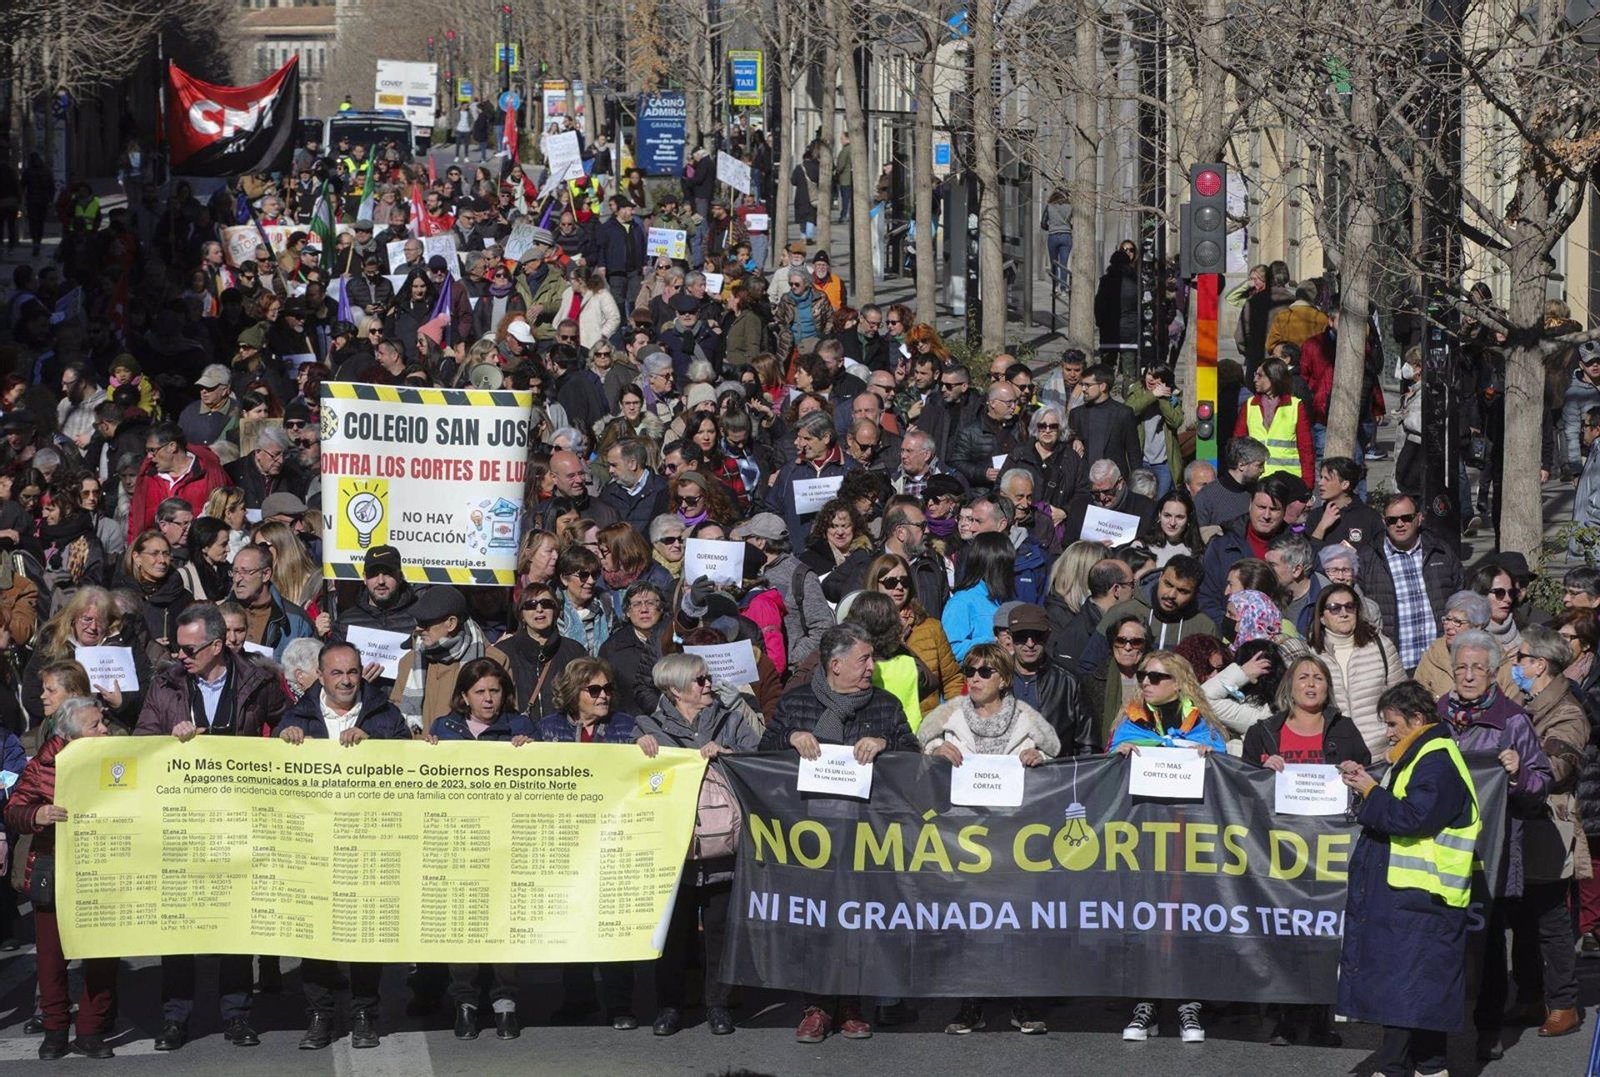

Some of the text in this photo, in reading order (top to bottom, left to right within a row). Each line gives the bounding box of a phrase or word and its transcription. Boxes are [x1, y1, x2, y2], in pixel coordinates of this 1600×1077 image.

[648, 98, 684, 107] CASINO
[189, 88, 280, 136] CNT
[344, 412, 428, 444] COLEGIO
[436, 418, 479, 446] SAN
[488, 419, 530, 447] JOS
[321, 453, 370, 476] ONTRA
[376, 456, 405, 478] LOS
[411, 458, 473, 481] CORTES
[480, 460, 500, 481] DE
[402, 511, 453, 525] NO HAY
[389, 528, 466, 544] EDUCACIÓN
[1095, 528, 1122, 537] APAGANDO
[167, 759, 594, 779] ¡No Más Cortes! ENDESA culpable Gobiernos Responsables.
[184, 774, 234, 784] Apagones
[237, 775, 299, 786] comunicados
[311, 778, 319, 786] la
[322, 779, 376, 788] plataforma
[426, 780, 438, 788] de
[441, 780, 466, 790] 2023,
[470, 781, 491, 789] solo
[510, 780, 546, 789] Distrito
[549, 781, 576, 789] Norte
[156, 785, 180, 794] Cada
[184, 785, 218, 794] número
[220, 785, 231, 793] de
[234, 785, 277, 796] incidencia
[280, 789, 332, 799] corresponde
[383, 790, 394, 799] de
[417, 792, 445, 800] familia
[467, 792, 504, 800] contrato
[506, 794, 512, 802] y
[514, 792, 522, 800] al
[524, 792, 564, 801] corriente
[567, 792, 578, 801] de
[580, 794, 604, 802] pago
[750, 813, 832, 869] NO
[854, 809, 992, 873] MÁS
[1269, 829, 1351, 880] DE
[749, 891, 780, 922] NI
[788, 895, 826, 928] EN
[838, 902, 1020, 930] GRANADA
[1031, 901, 1067, 929] NI
[1079, 900, 1124, 929] EN
[1133, 902, 1250, 934] OTROS
